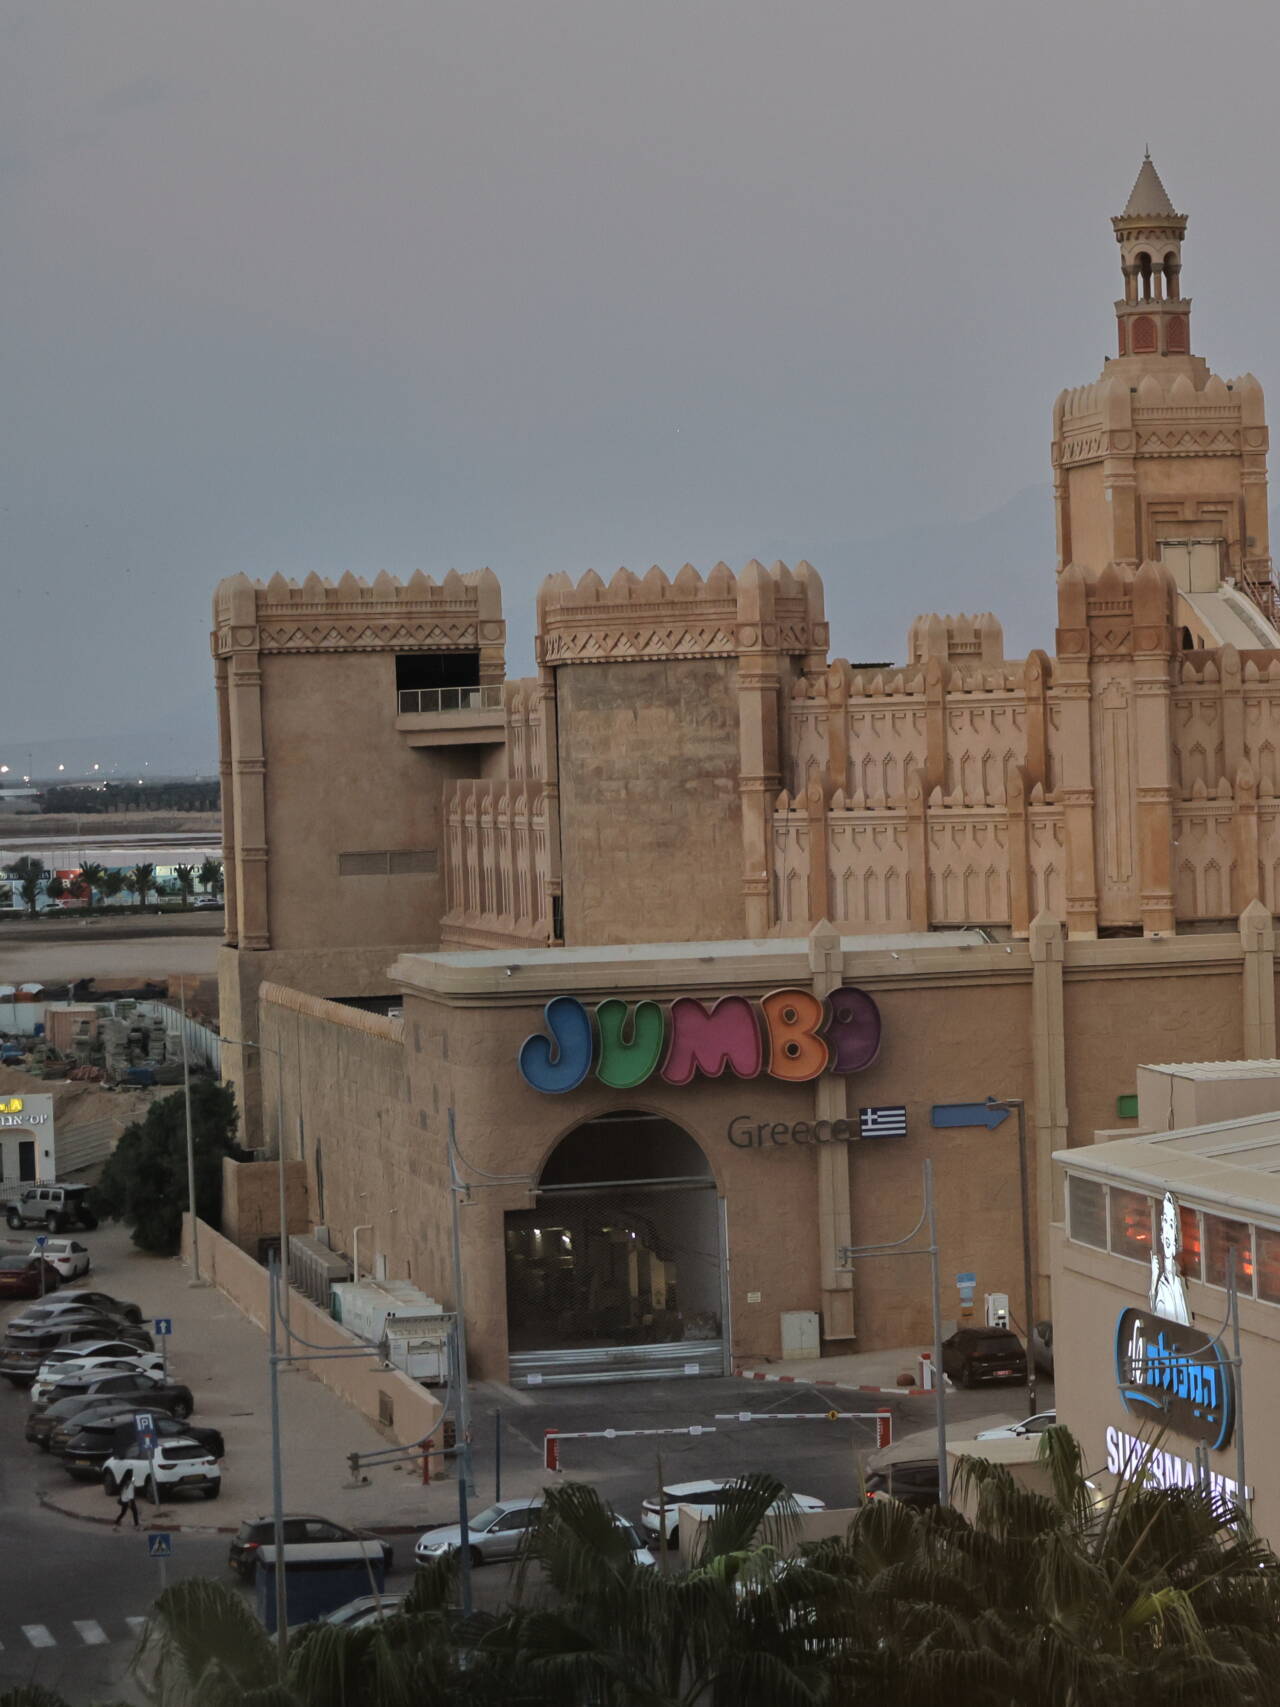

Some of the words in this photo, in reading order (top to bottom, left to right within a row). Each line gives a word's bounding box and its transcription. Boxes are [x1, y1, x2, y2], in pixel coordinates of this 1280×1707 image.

[518, 987, 882, 1094] JUMBO
[727, 1115, 852, 1148] Greece
[1106, 1426, 1249, 1531] SUPRMAKE
